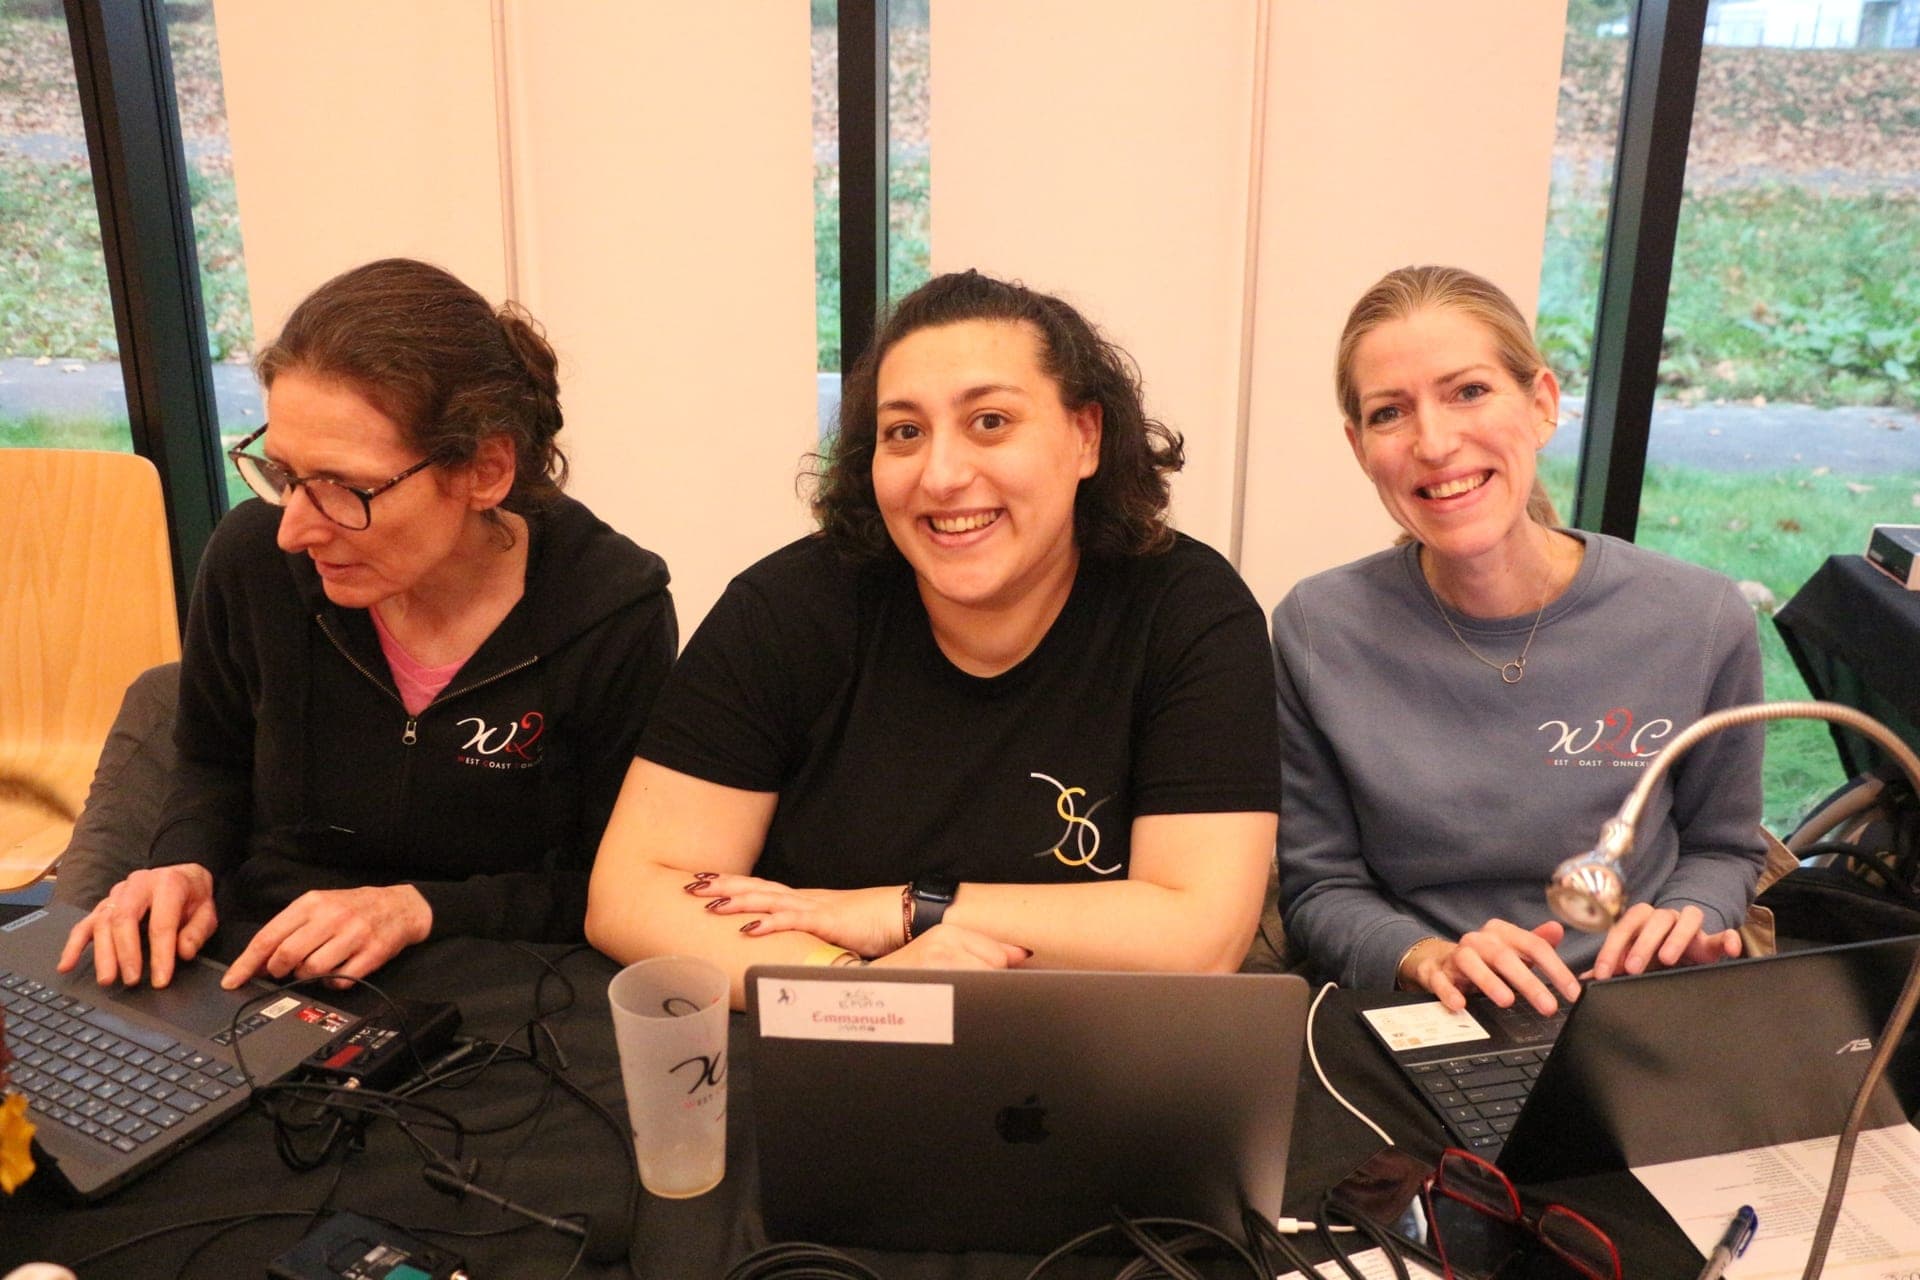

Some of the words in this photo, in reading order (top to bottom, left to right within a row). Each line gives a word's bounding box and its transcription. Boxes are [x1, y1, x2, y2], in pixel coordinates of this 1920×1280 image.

[456, 710, 545, 760] W2
[1545, 758, 1569, 767] WEST
[1572, 758, 1603, 768] COAST
[812, 1010, 905, 1025] Emmanuelle
